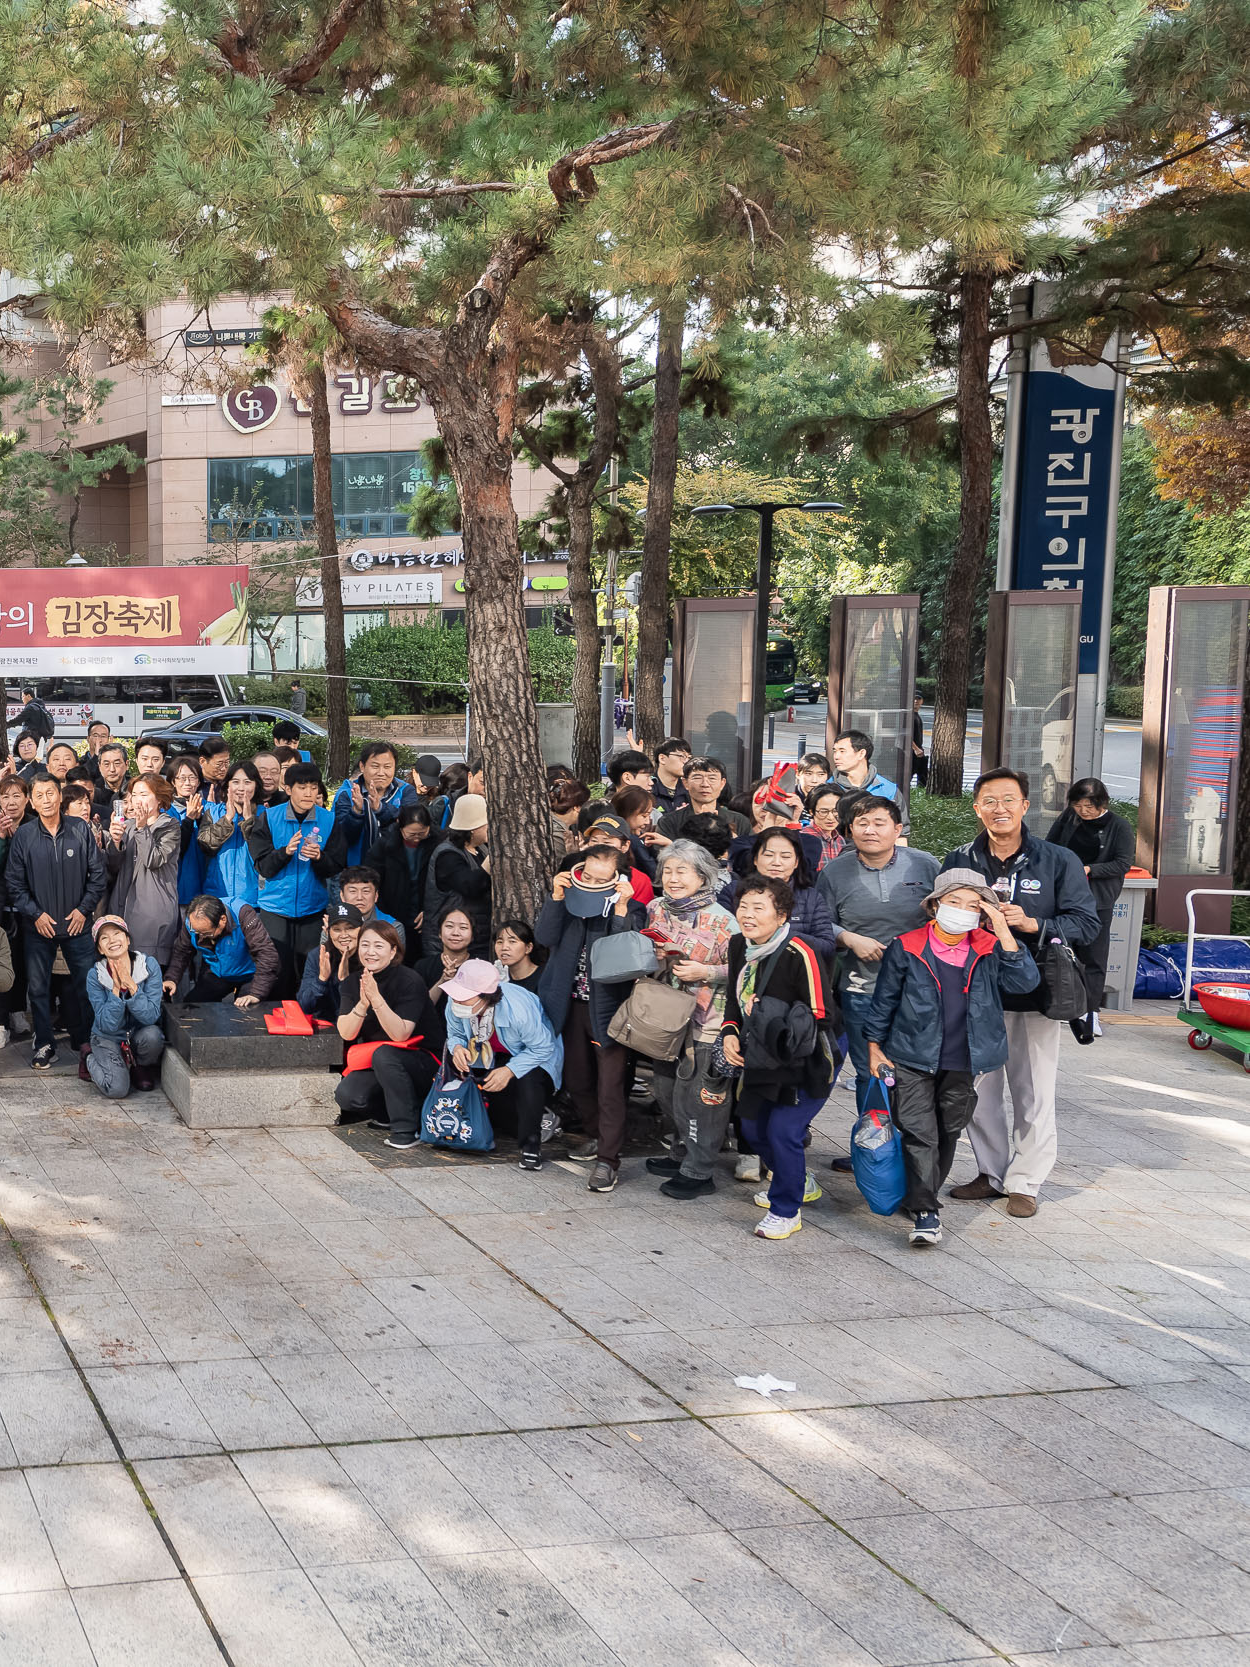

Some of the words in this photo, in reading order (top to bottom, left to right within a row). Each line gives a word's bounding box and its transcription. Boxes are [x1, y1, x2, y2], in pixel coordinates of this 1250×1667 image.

[378, 549, 466, 569] 박승철헤
[368, 582, 434, 592] PILATES
[55, 600, 172, 635] 김장축제
[1079, 635, 1094, 643] GU
[73, 657, 86, 665] KB
